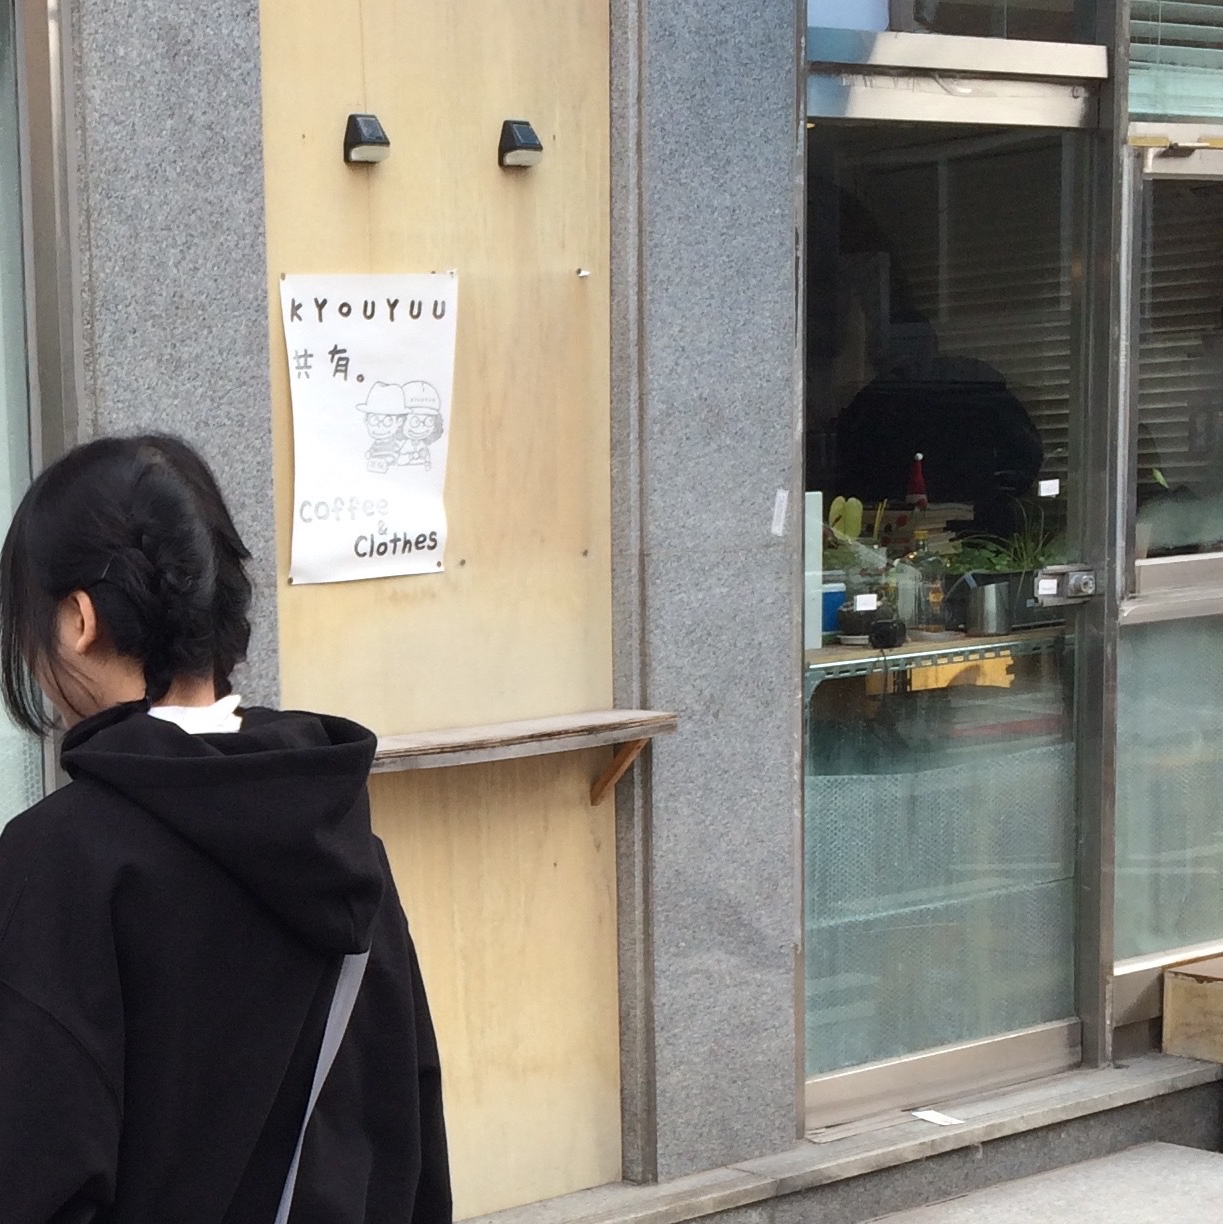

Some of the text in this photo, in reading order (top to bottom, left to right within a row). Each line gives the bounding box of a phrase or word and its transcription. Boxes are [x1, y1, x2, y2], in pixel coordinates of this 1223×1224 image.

[290, 298, 447, 323] KYOUYUU
[376, 520, 389, 536] &
[354, 530, 438, 558] Clothes
